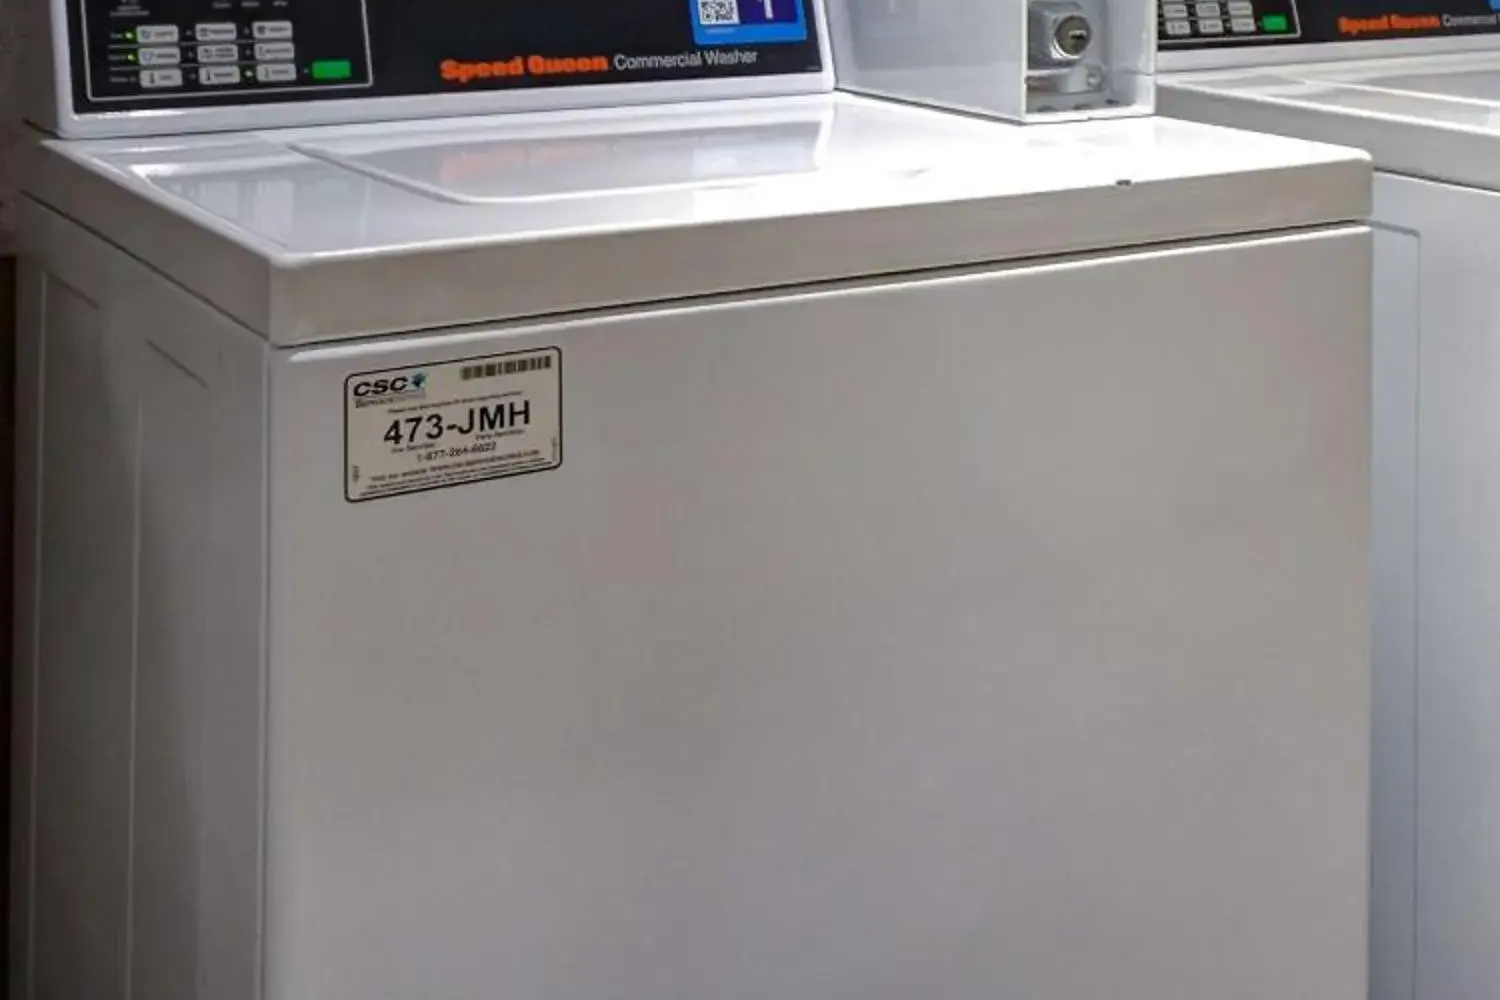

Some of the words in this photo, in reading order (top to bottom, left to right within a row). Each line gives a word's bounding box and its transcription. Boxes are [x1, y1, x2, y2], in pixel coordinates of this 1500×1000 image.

[440, 57, 524, 83] Speed
[528, 55, 608, 75] Queen
[613, 51, 700, 71] Commercial
[704, 49, 757, 65] Washer
[353, 376, 408, 397] CSC
[383, 400, 530, 444] 473-JMH
